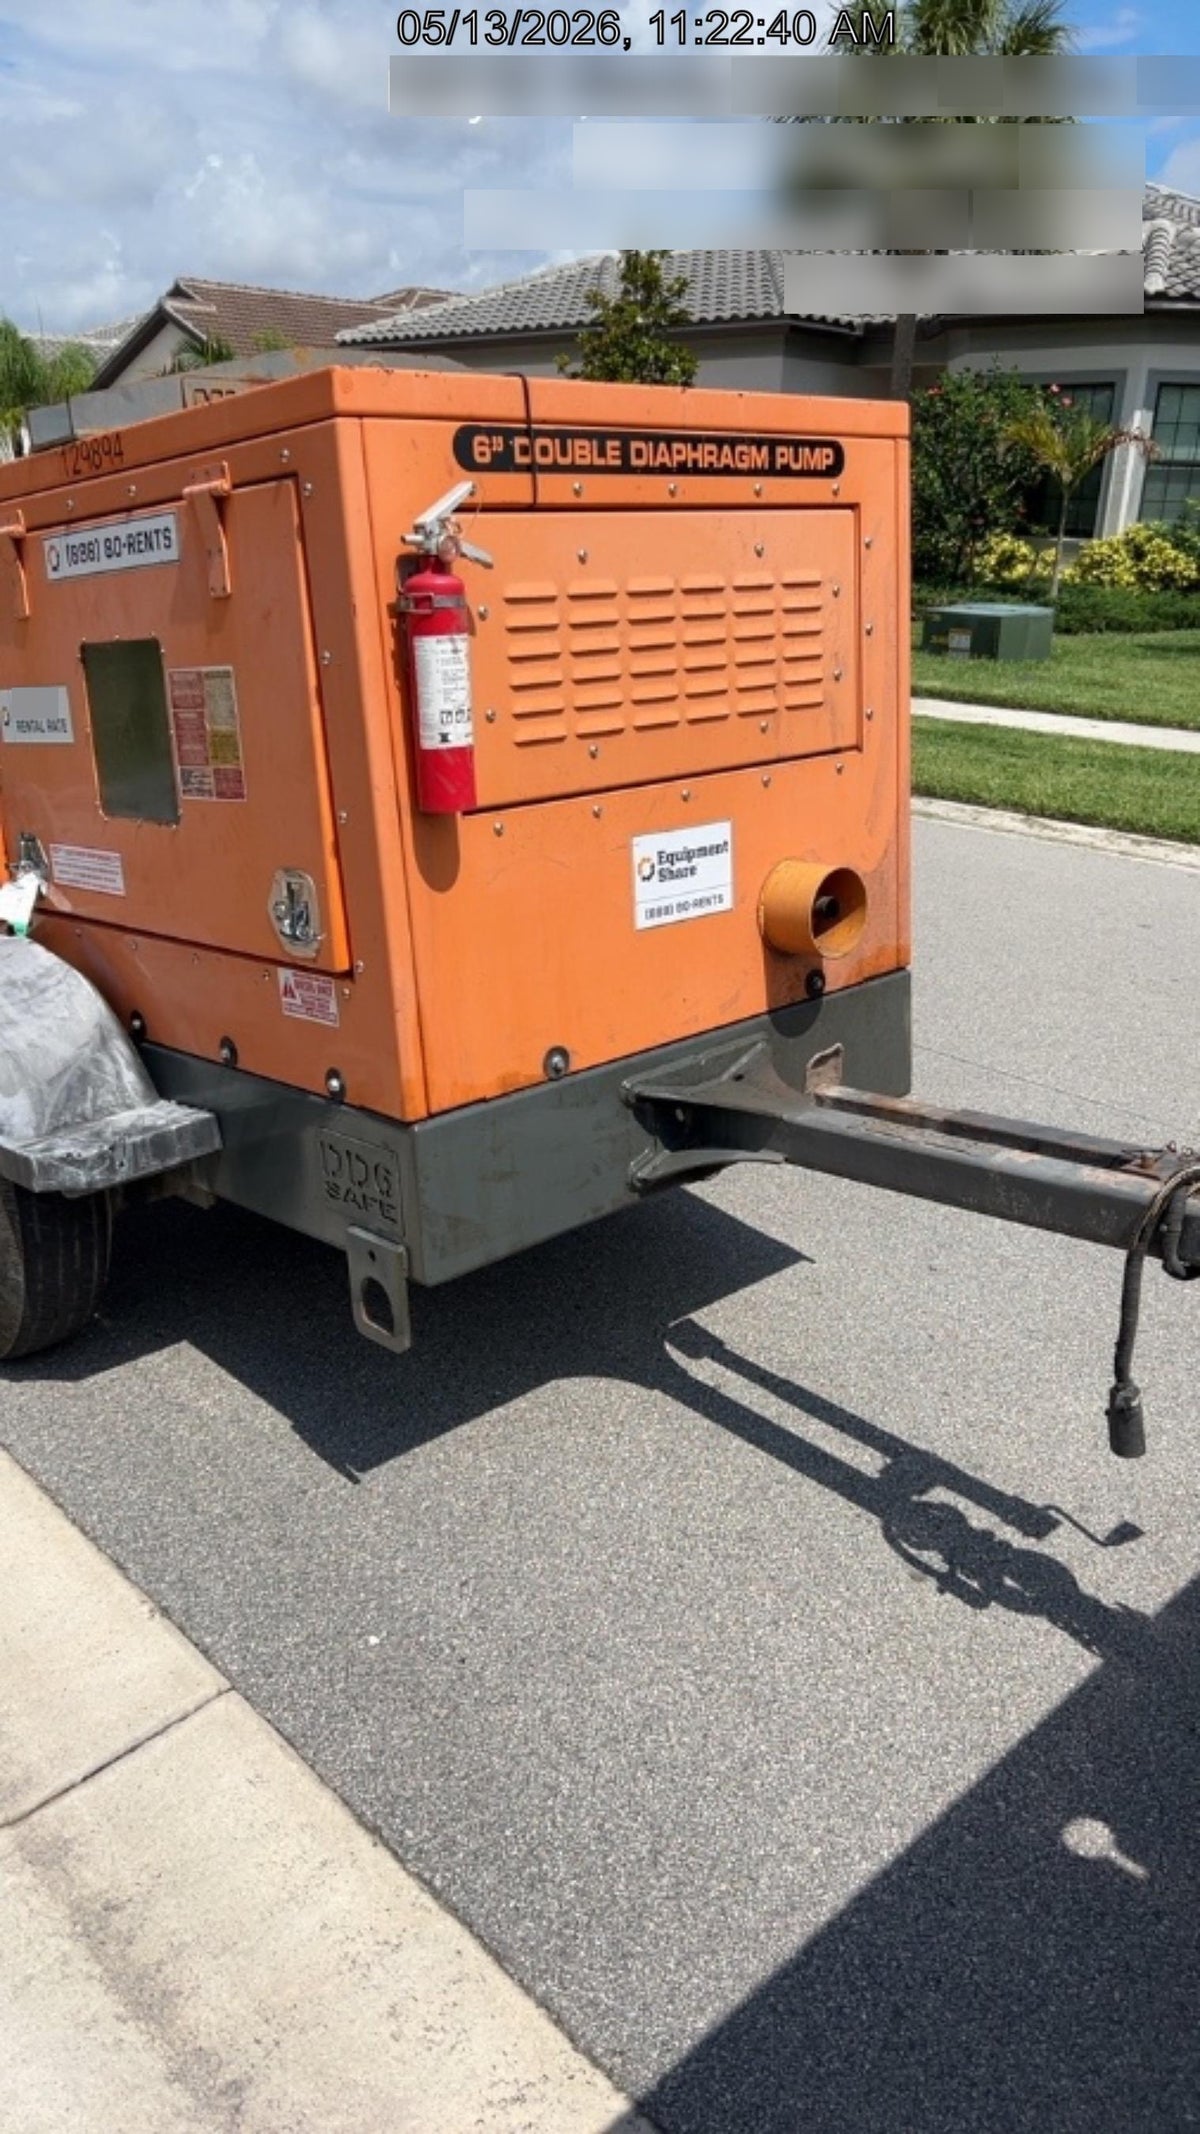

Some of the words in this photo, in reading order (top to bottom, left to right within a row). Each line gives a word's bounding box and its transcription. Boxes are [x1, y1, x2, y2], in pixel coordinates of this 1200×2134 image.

[60, 432, 124, 478] 129894
[513, 435, 622, 466] DOUBLE
[629, 440, 769, 470] DIAPHRAGM
[775, 446, 834, 470] PUMP
[656, 840, 729, 866] Equipment
[657, 865, 698, 883] Share
[325, 1179, 398, 1224] SAFE
